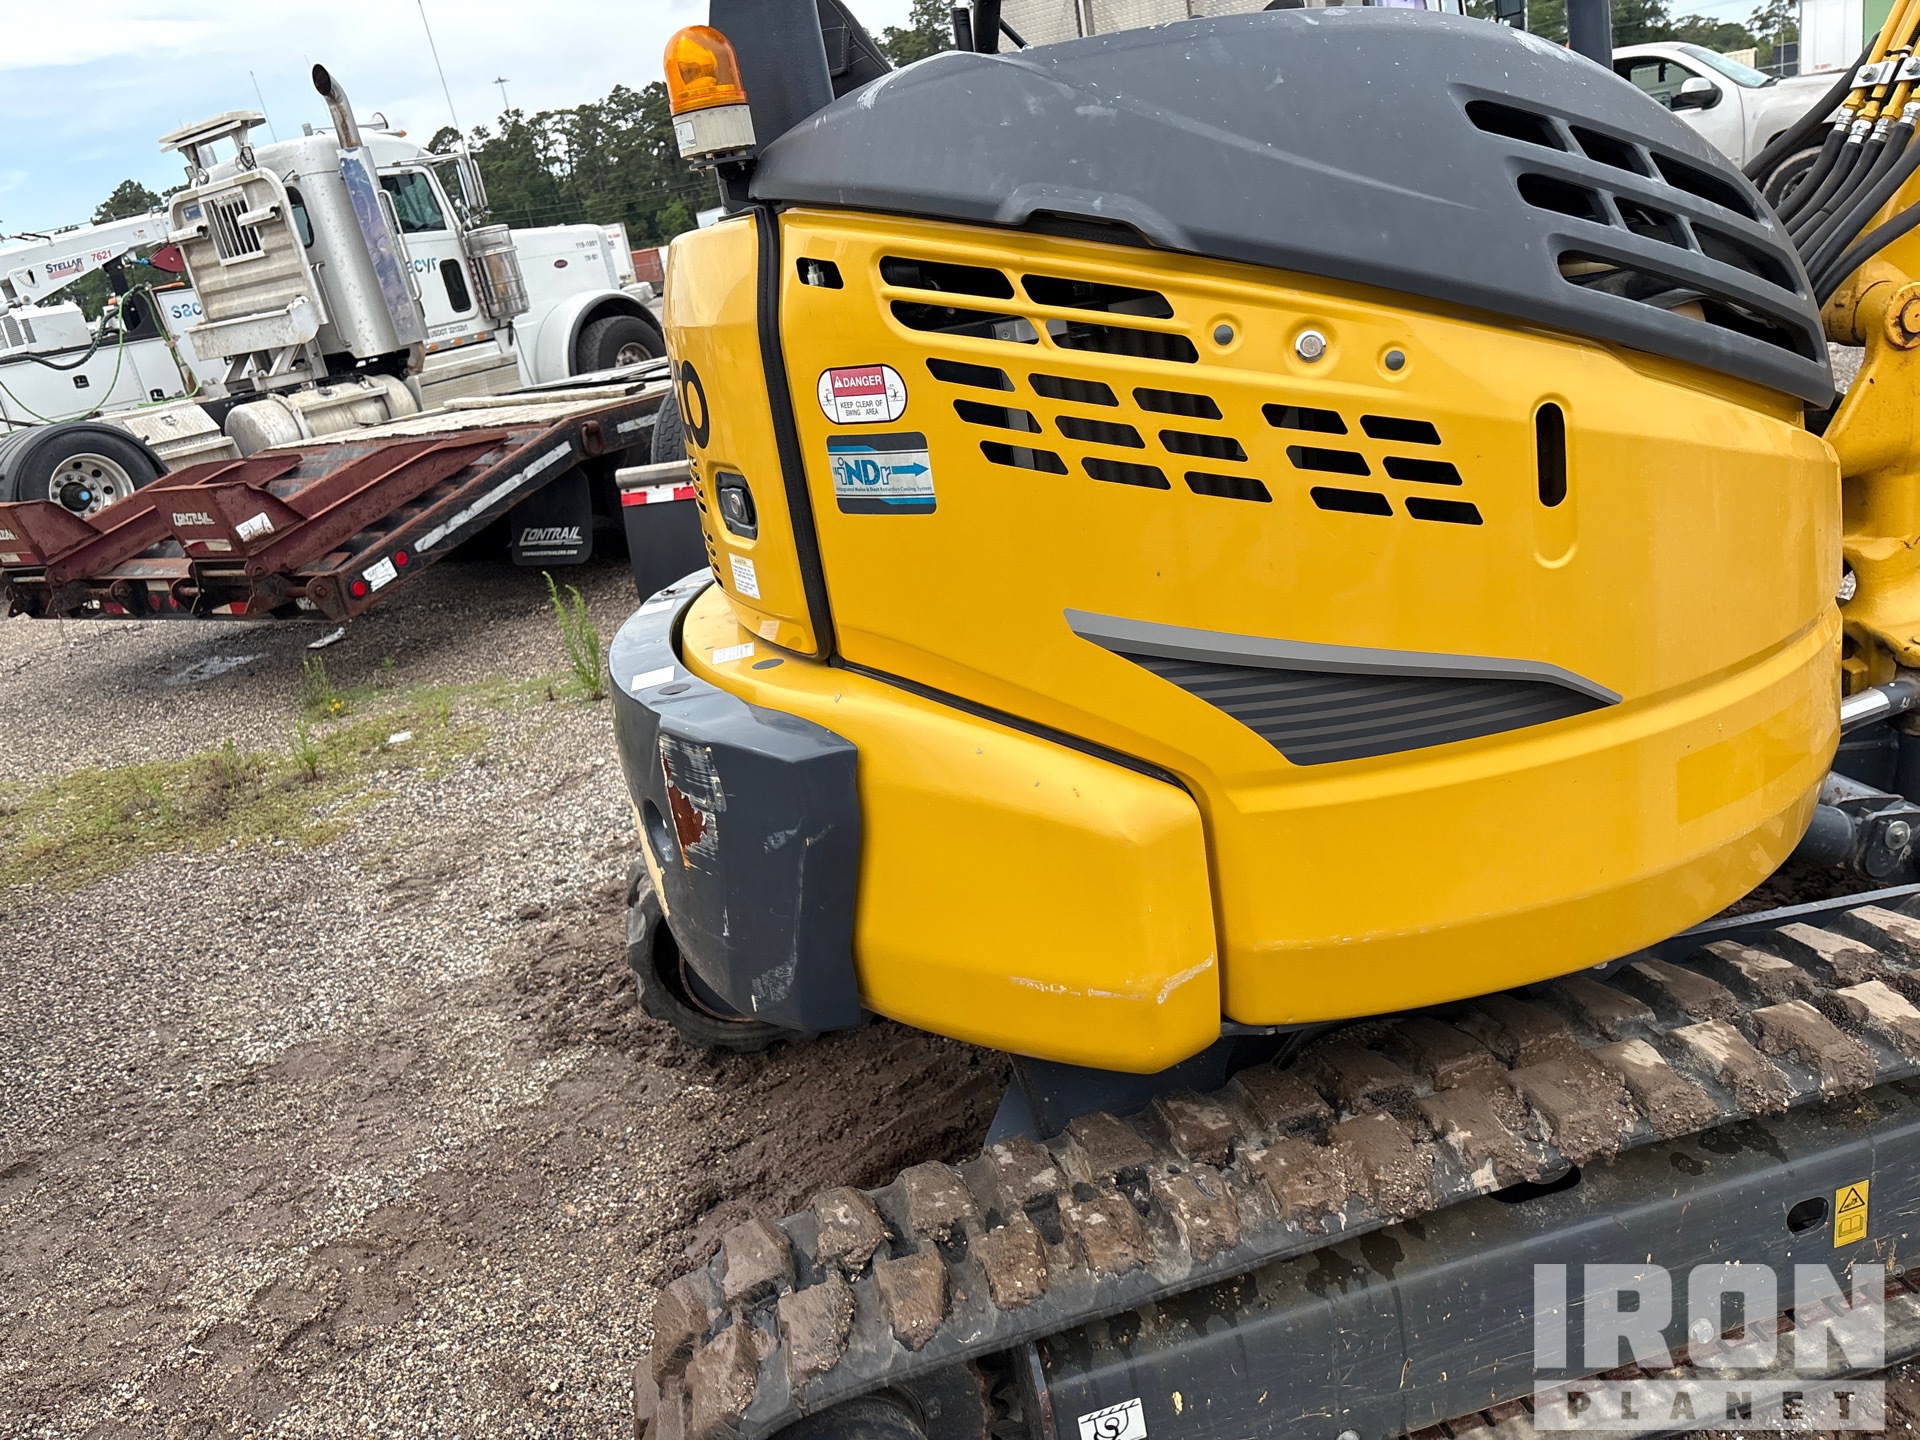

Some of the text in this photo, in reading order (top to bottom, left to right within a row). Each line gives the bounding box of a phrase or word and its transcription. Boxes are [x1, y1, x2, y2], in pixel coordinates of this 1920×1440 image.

[45, 249, 112, 274] STELLAR 7621
[842, 374, 883, 388] DANGER
[840, 399, 883, 409] KEEP CLEAR OF
[845, 407, 879, 417] SWING AREA
[518, 526, 583, 547] CONTRAIL
